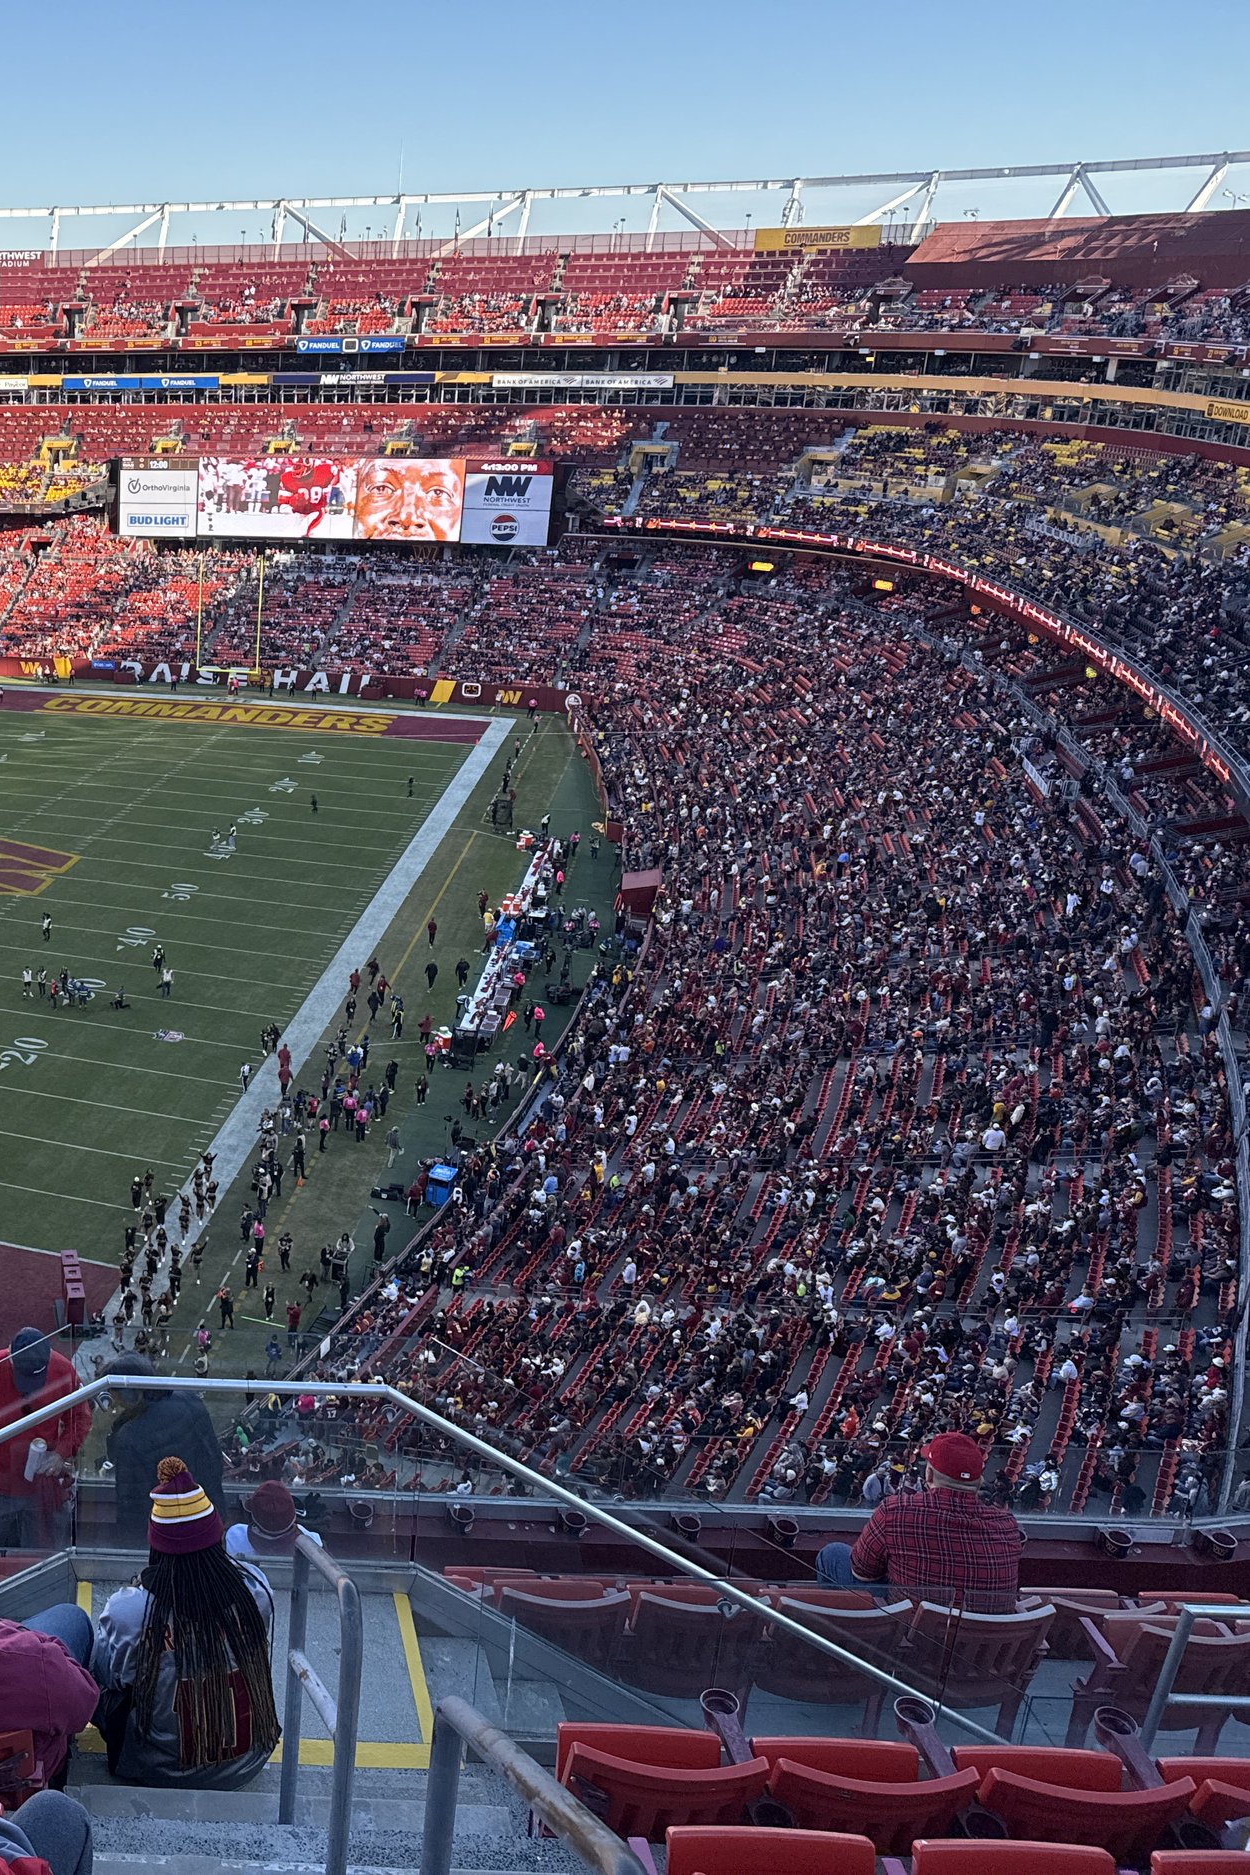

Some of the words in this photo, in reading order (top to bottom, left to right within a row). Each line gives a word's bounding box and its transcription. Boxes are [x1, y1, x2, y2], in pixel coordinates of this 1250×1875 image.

[784, 232, 850, 244] COMMANDERS
[319, 374, 340, 384] NW
[1214, 406, 1249, 420] DOWNLOAD
[149, 460, 168, 469] 12:00
[481, 463, 519, 471] 4:13:00
[520, 463, 538, 472] PM
[142, 484, 191, 493] OrthoVirginia
[484, 475, 533, 497] NW
[483, 496, 531, 504] NORTHWEST
[129, 516, 153, 525] BUD
[154, 516, 187, 525] LIGHT
[491, 524, 518, 532] PEPSI
[465, 685, 478, 695] 25
[42, 696, 394, 733] COMMANDERS
[297, 753, 325, 764] 10
[268, 780, 299, 793] 20
[237, 811, 269, 825] 30
[161, 883, 199, 901] 50
[117, 927, 156, 947] 40
[0, 1037, 49, 1065] 20
[327, 1410, 337, 1418] 17
